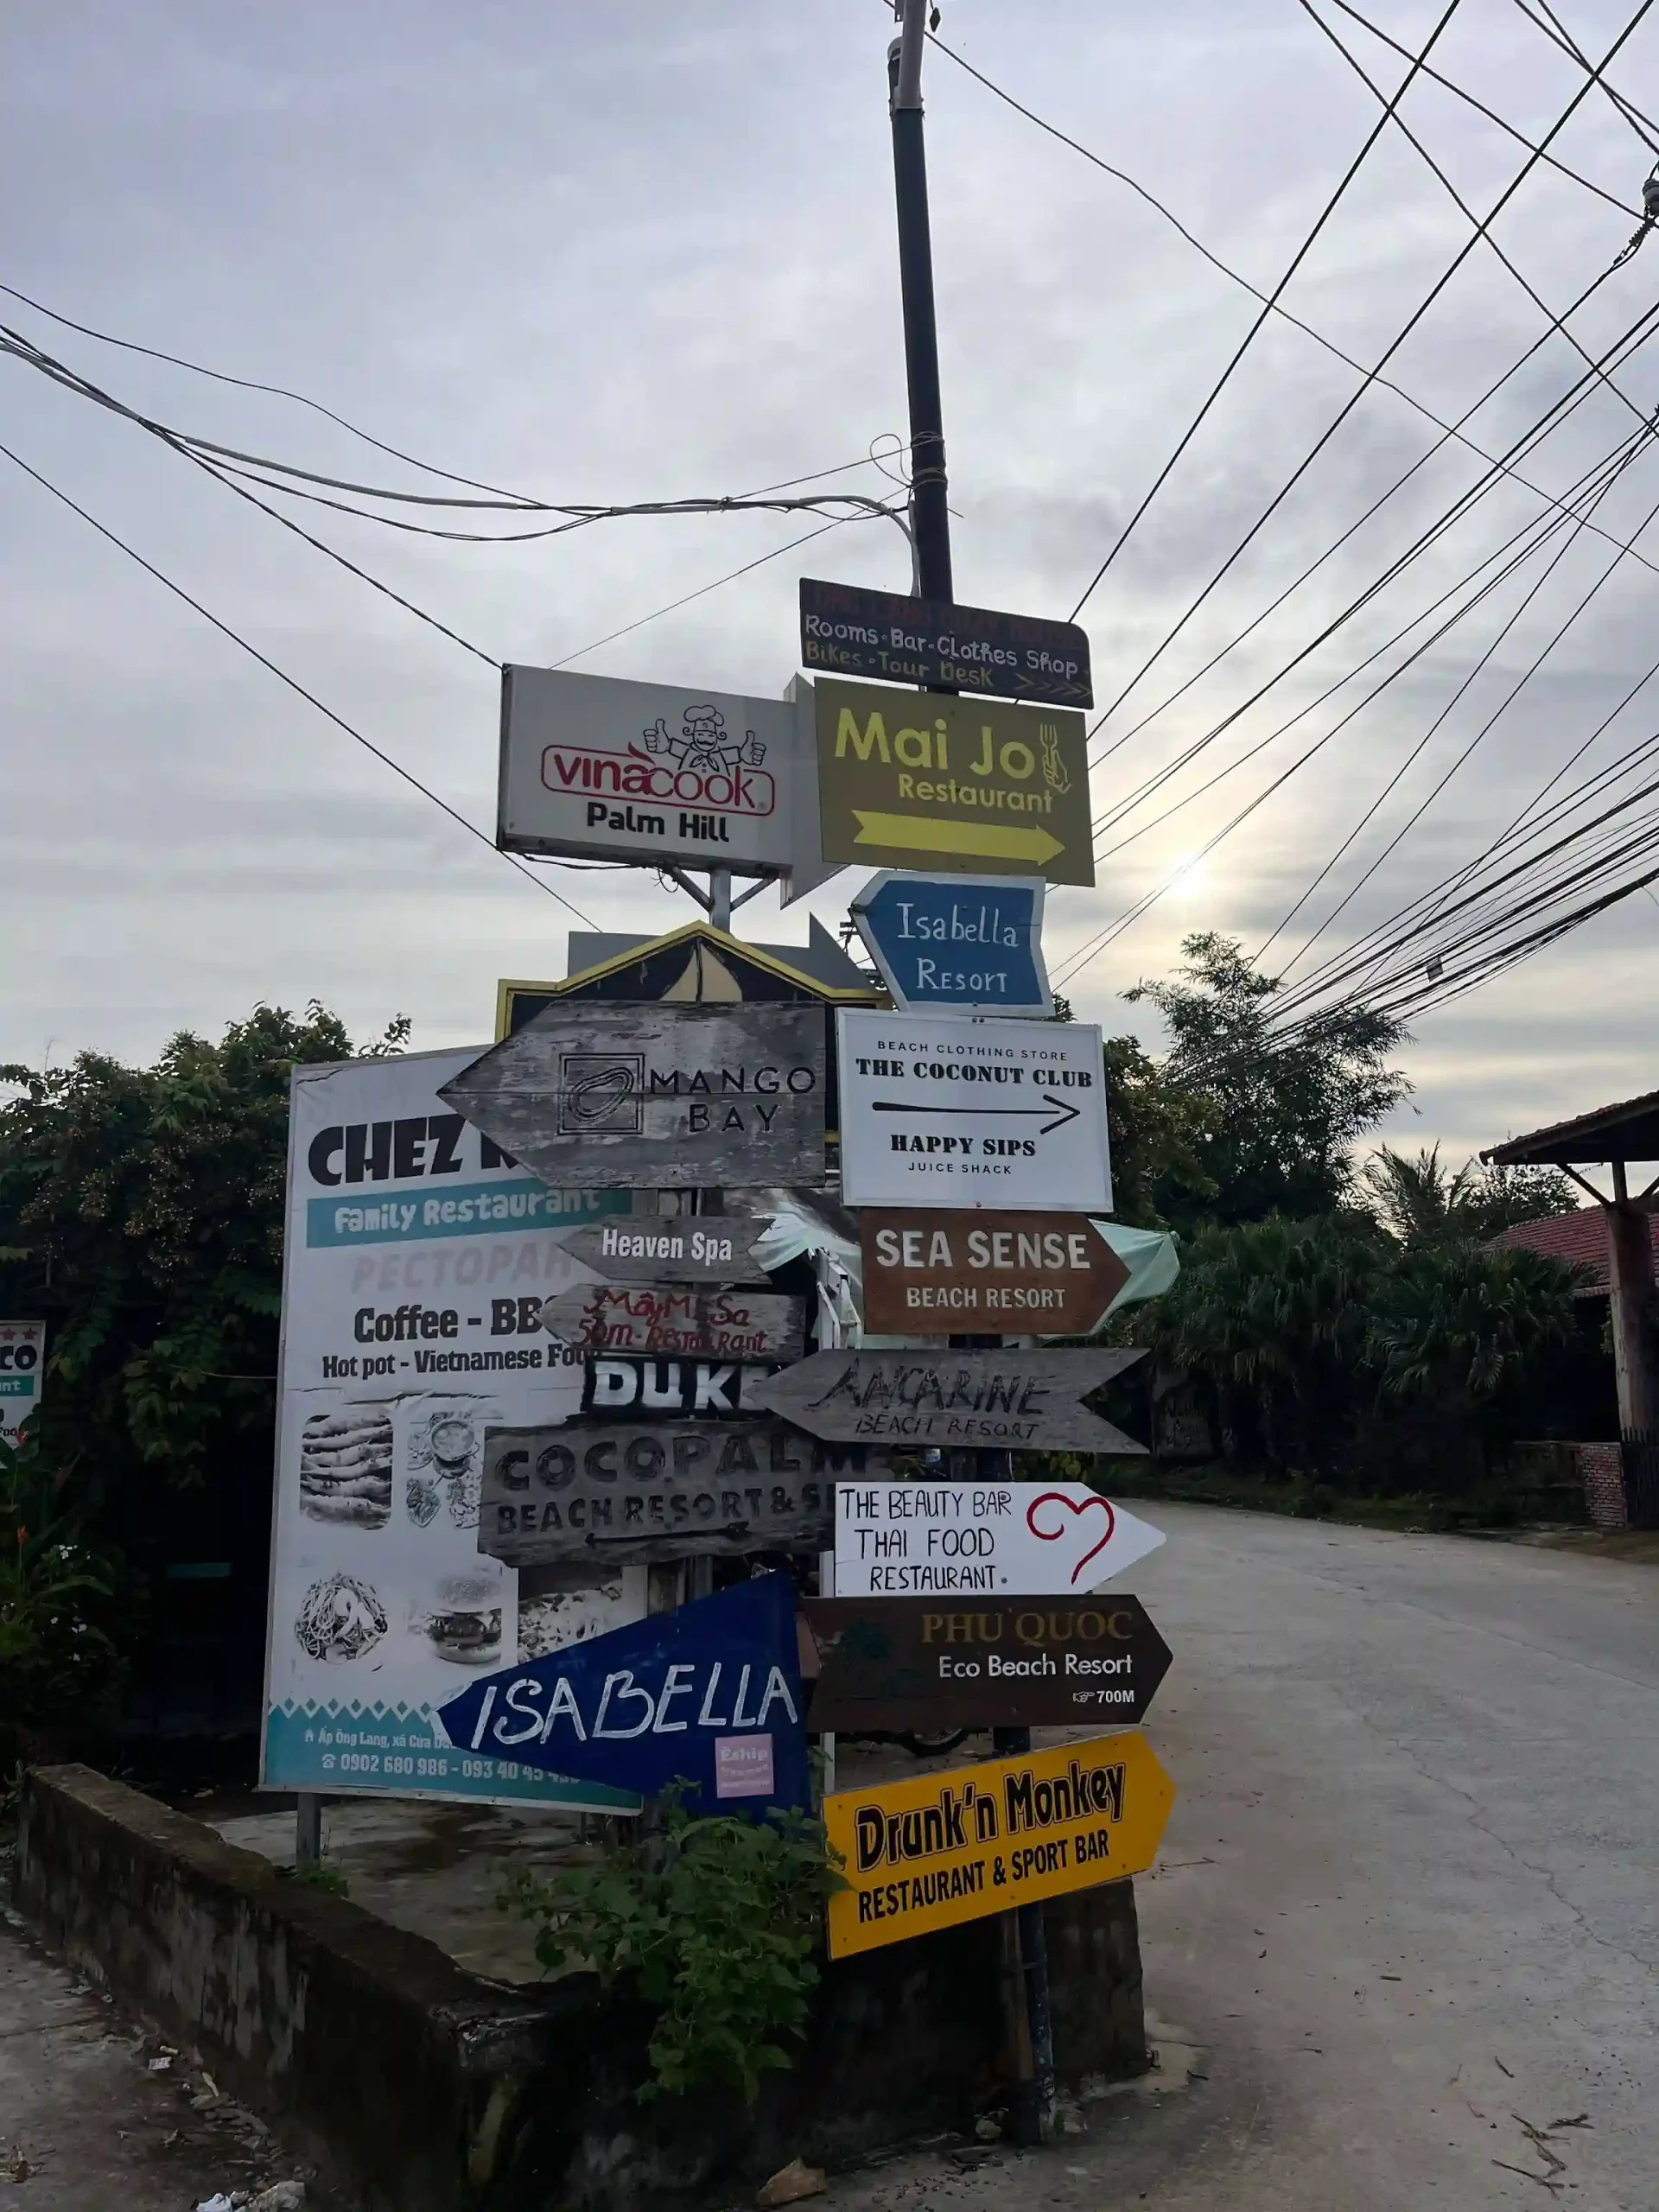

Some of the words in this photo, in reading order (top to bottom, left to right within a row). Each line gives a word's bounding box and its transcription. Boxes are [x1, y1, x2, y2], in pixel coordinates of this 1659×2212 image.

[804, 613, 878, 645] Rooms
[890, 627, 927, 652] Bar
[938, 635, 1018, 668] Clothes
[1027, 650, 1078, 678] Shop
[804, 639, 863, 668] Bikes
[877, 652, 931, 680] Tour
[940, 661, 994, 688] Desk
[835, 707, 949, 770] Mai
[969, 725, 1035, 779] Jo
[898, 772, 1053, 814] Restaurant
[587, 802, 665, 836] Palm
[679, 811, 729, 843] Hill
[895, 902, 1020, 948] Isabella
[916, 957, 1008, 993] Resort
[877, 1039, 929, 1052] BEACH
[937, 1045, 1014, 1058] CLOTHING
[1021, 1050, 1068, 1062] STORE
[650, 1066, 817, 1095] MANGO
[855, 1058, 905, 1078] THE
[913, 1062, 1025, 1084] COCONUT
[1033, 1069, 1093, 1088] CLUB
[689, 1103, 782, 1134] BAY
[308, 1113, 467, 1186] CHEZ
[890, 1134, 975, 1154] HAPPY
[982, 1139, 1037, 1157] SIPS
[908, 1161, 955, 1173] JUICE
[961, 1164, 1013, 1175] SHACK
[423, 1187, 601, 1227] Restaurant
[601, 1228, 683, 1260] Heaven
[691, 1231, 733, 1267] Spa
[874, 1229, 954, 1268] SEA
[967, 1230, 1092, 1270] SENSE
[906, 1287, 978, 1308] BEACH
[985, 1287, 1066, 1309] RESORT
[353, 1303, 459, 1344] Coffee
[490, 1294, 558, 1337] BB
[322, 1354, 358, 1379] Hot
[362, 1353, 396, 1381] pot
[414, 1347, 543, 1374] Vietnamese
[854, 1413, 934, 1436] BEACH
[948, 1419, 1041, 1441] RESORT
[496, 1497, 613, 1535] BEACH
[624, 1487, 765, 1525] RESORT
[838, 1488, 880, 1520] THE
[888, 1489, 964, 1519] BEAUTY
[973, 1490, 1013, 1517] BAR
[854, 1528, 908, 1560] THAI
[927, 1528, 995, 1558] FOOD
[870, 1564, 997, 1592] RESTAURANT
[920, 1612, 1004, 1644] PHU
[938, 1656, 981, 1679] Eco
[988, 1654, 1057, 1677] Beach
[1065, 1652, 1134, 1675] Resort
[470, 1661, 799, 1750] ISABELLA
[1096, 1689, 1135, 1705] 700M
[340, 1753, 380, 1772] 0902
[383, 1755, 414, 1775] 680
[416, 1758, 448, 1777] 986
[461, 1759, 493, 1780] 093
[855, 1782, 999, 1872] Drunk'n
[1003, 1759, 1127, 1835] Monkey
[858, 1859, 986, 1923] RESTAURANT
[992, 1854, 1007, 1887] &
[1011, 1839, 1069, 1881] SPORT
[1075, 1828, 1110, 1865] BAR
